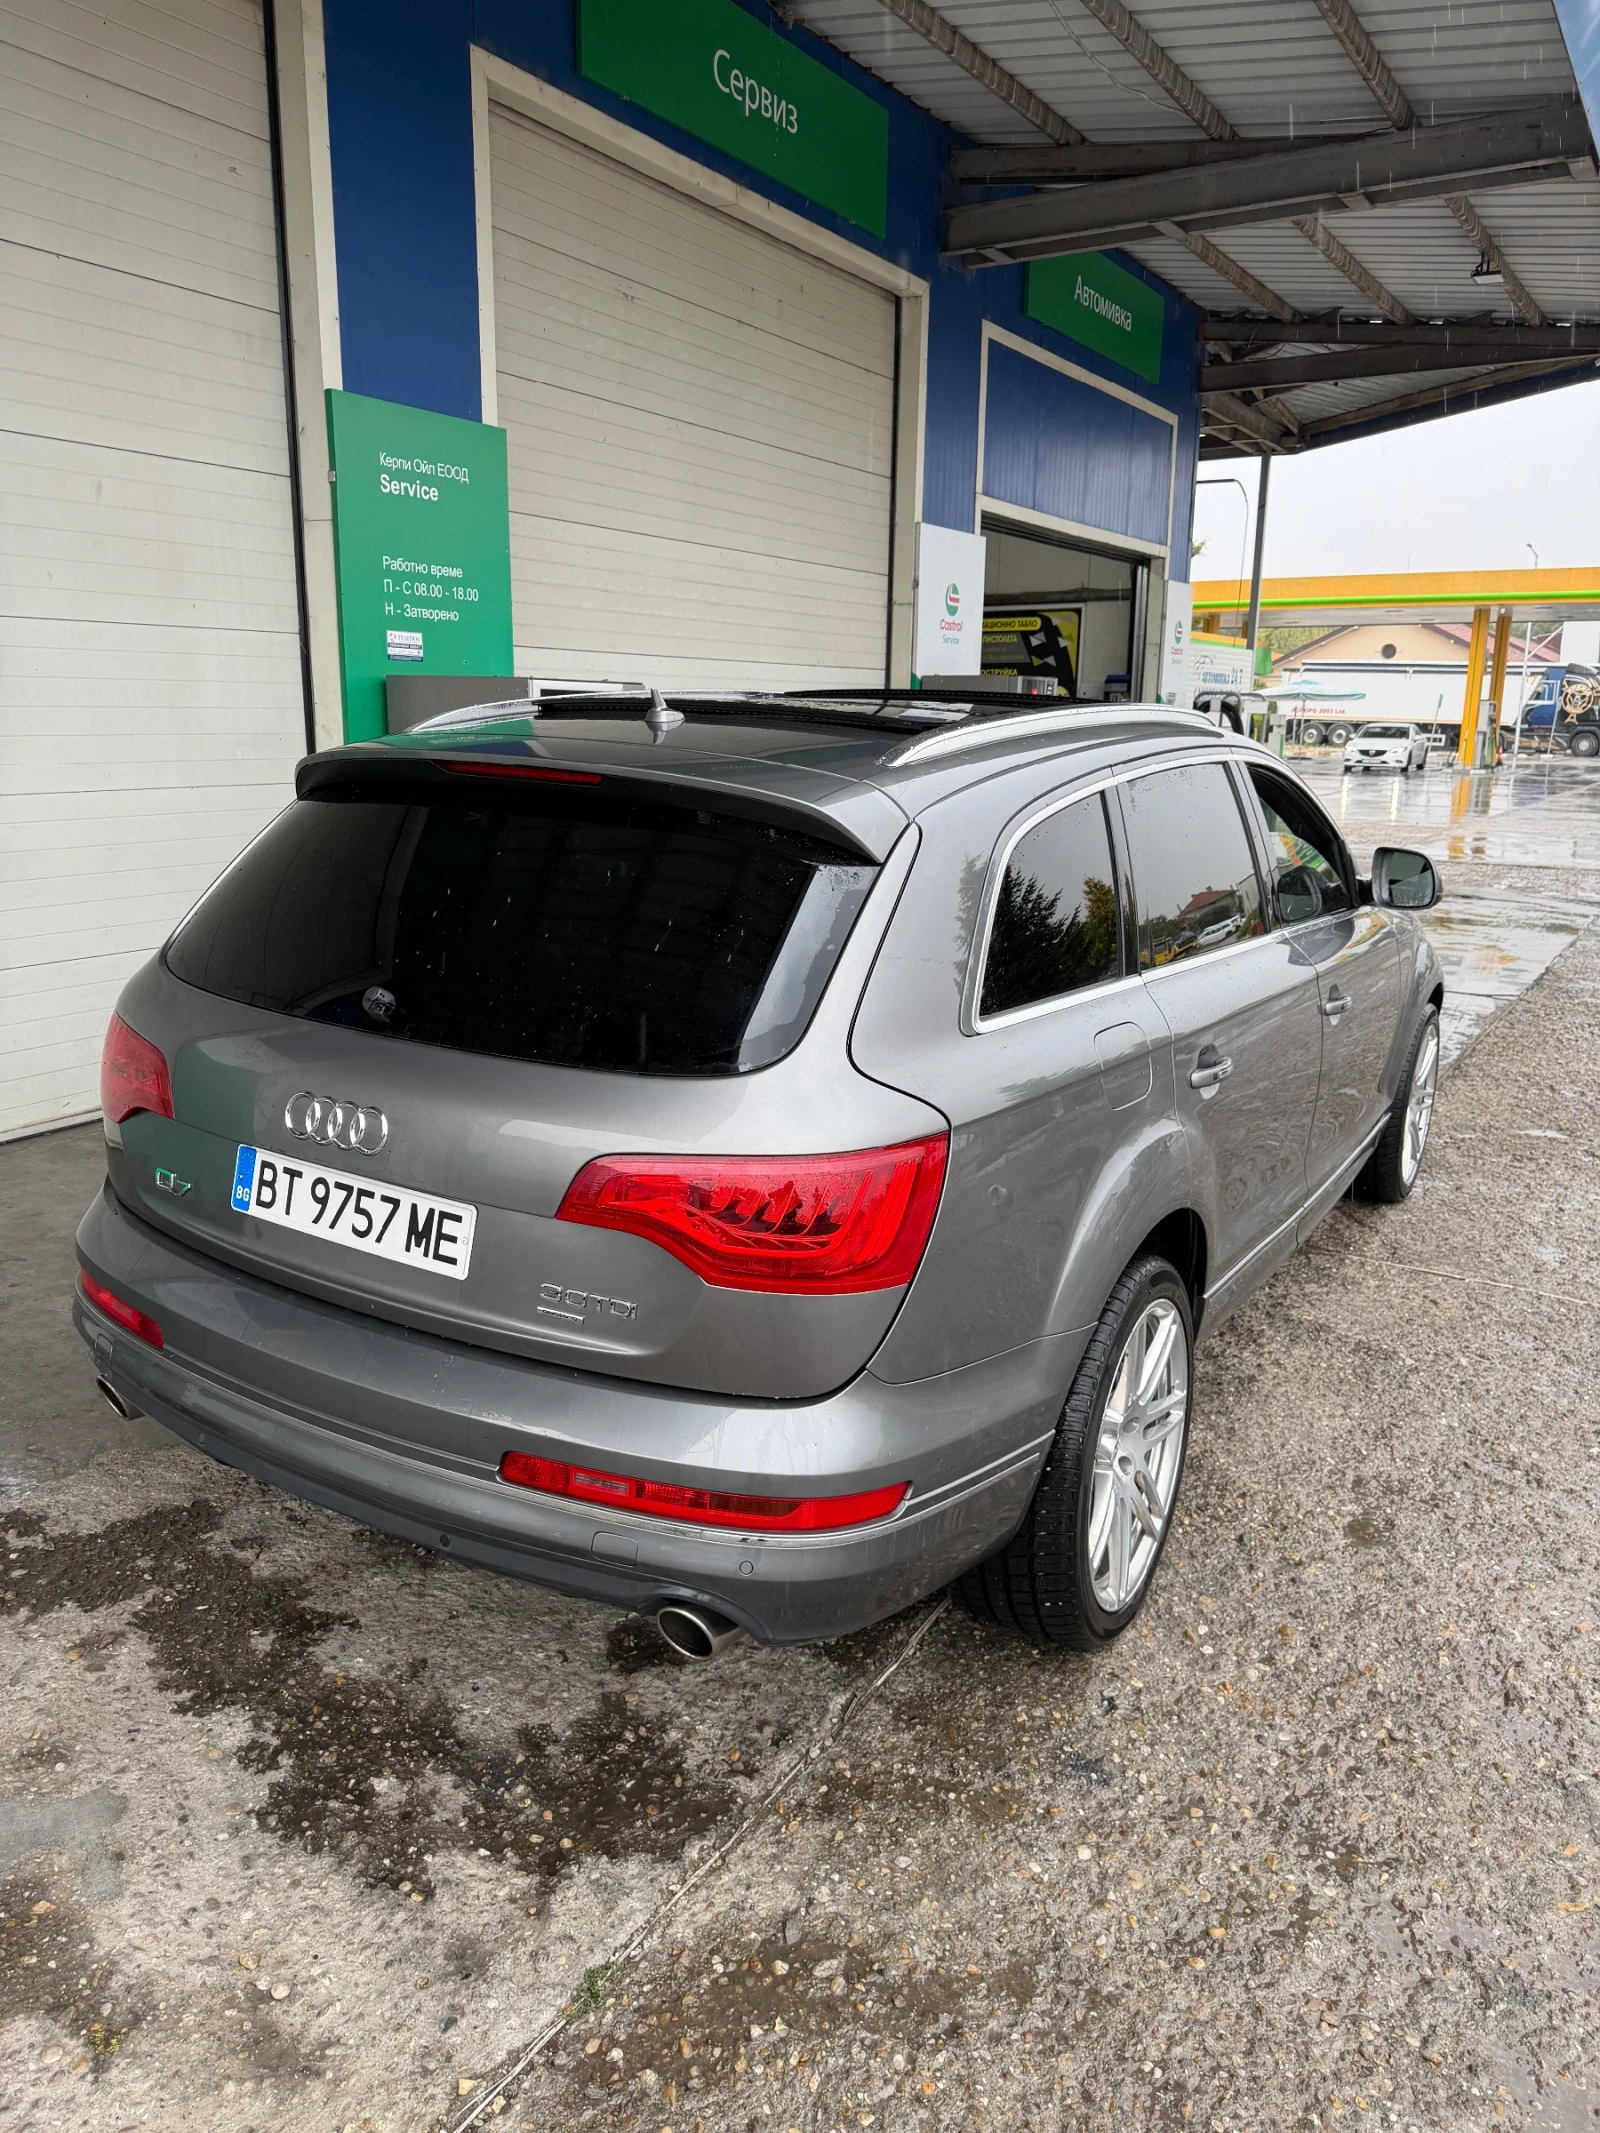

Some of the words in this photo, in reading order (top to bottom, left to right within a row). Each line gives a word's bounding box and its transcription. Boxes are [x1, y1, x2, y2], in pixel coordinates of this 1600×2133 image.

[713, 49, 798, 134] Сервиз
[1074, 274, 1132, 332] Автомивка
[379, 451, 411, 471] Керпи
[413, 458, 436, 475] Ойл
[437, 462, 470, 485] ЕООД
[380, 473, 439, 501] Service
[382, 555, 428, 574] Работно
[430, 564, 463, 579] време
[383, 579, 393, 593] П
[402, 581, 411, 595] С
[413, 582, 443, 598] 08.00
[452, 586, 479, 602] 18.00
[384, 602, 394, 616] Н
[403, 603, 459, 622] Затворено
[983, 620, 1016, 629] АЦИОННО
[1017, 619, 1038, 628] ТАБЛО
[940, 618, 963, 632] Castrol
[942, 634, 960, 645] Service
[155, 1167, 192, 1198] Q7
[235, 1185, 250, 1202] BG
[255, 1160, 303, 1216] BT
[310, 1176, 401, 1244] 9757
[404, 1203, 463, 1266] ME
